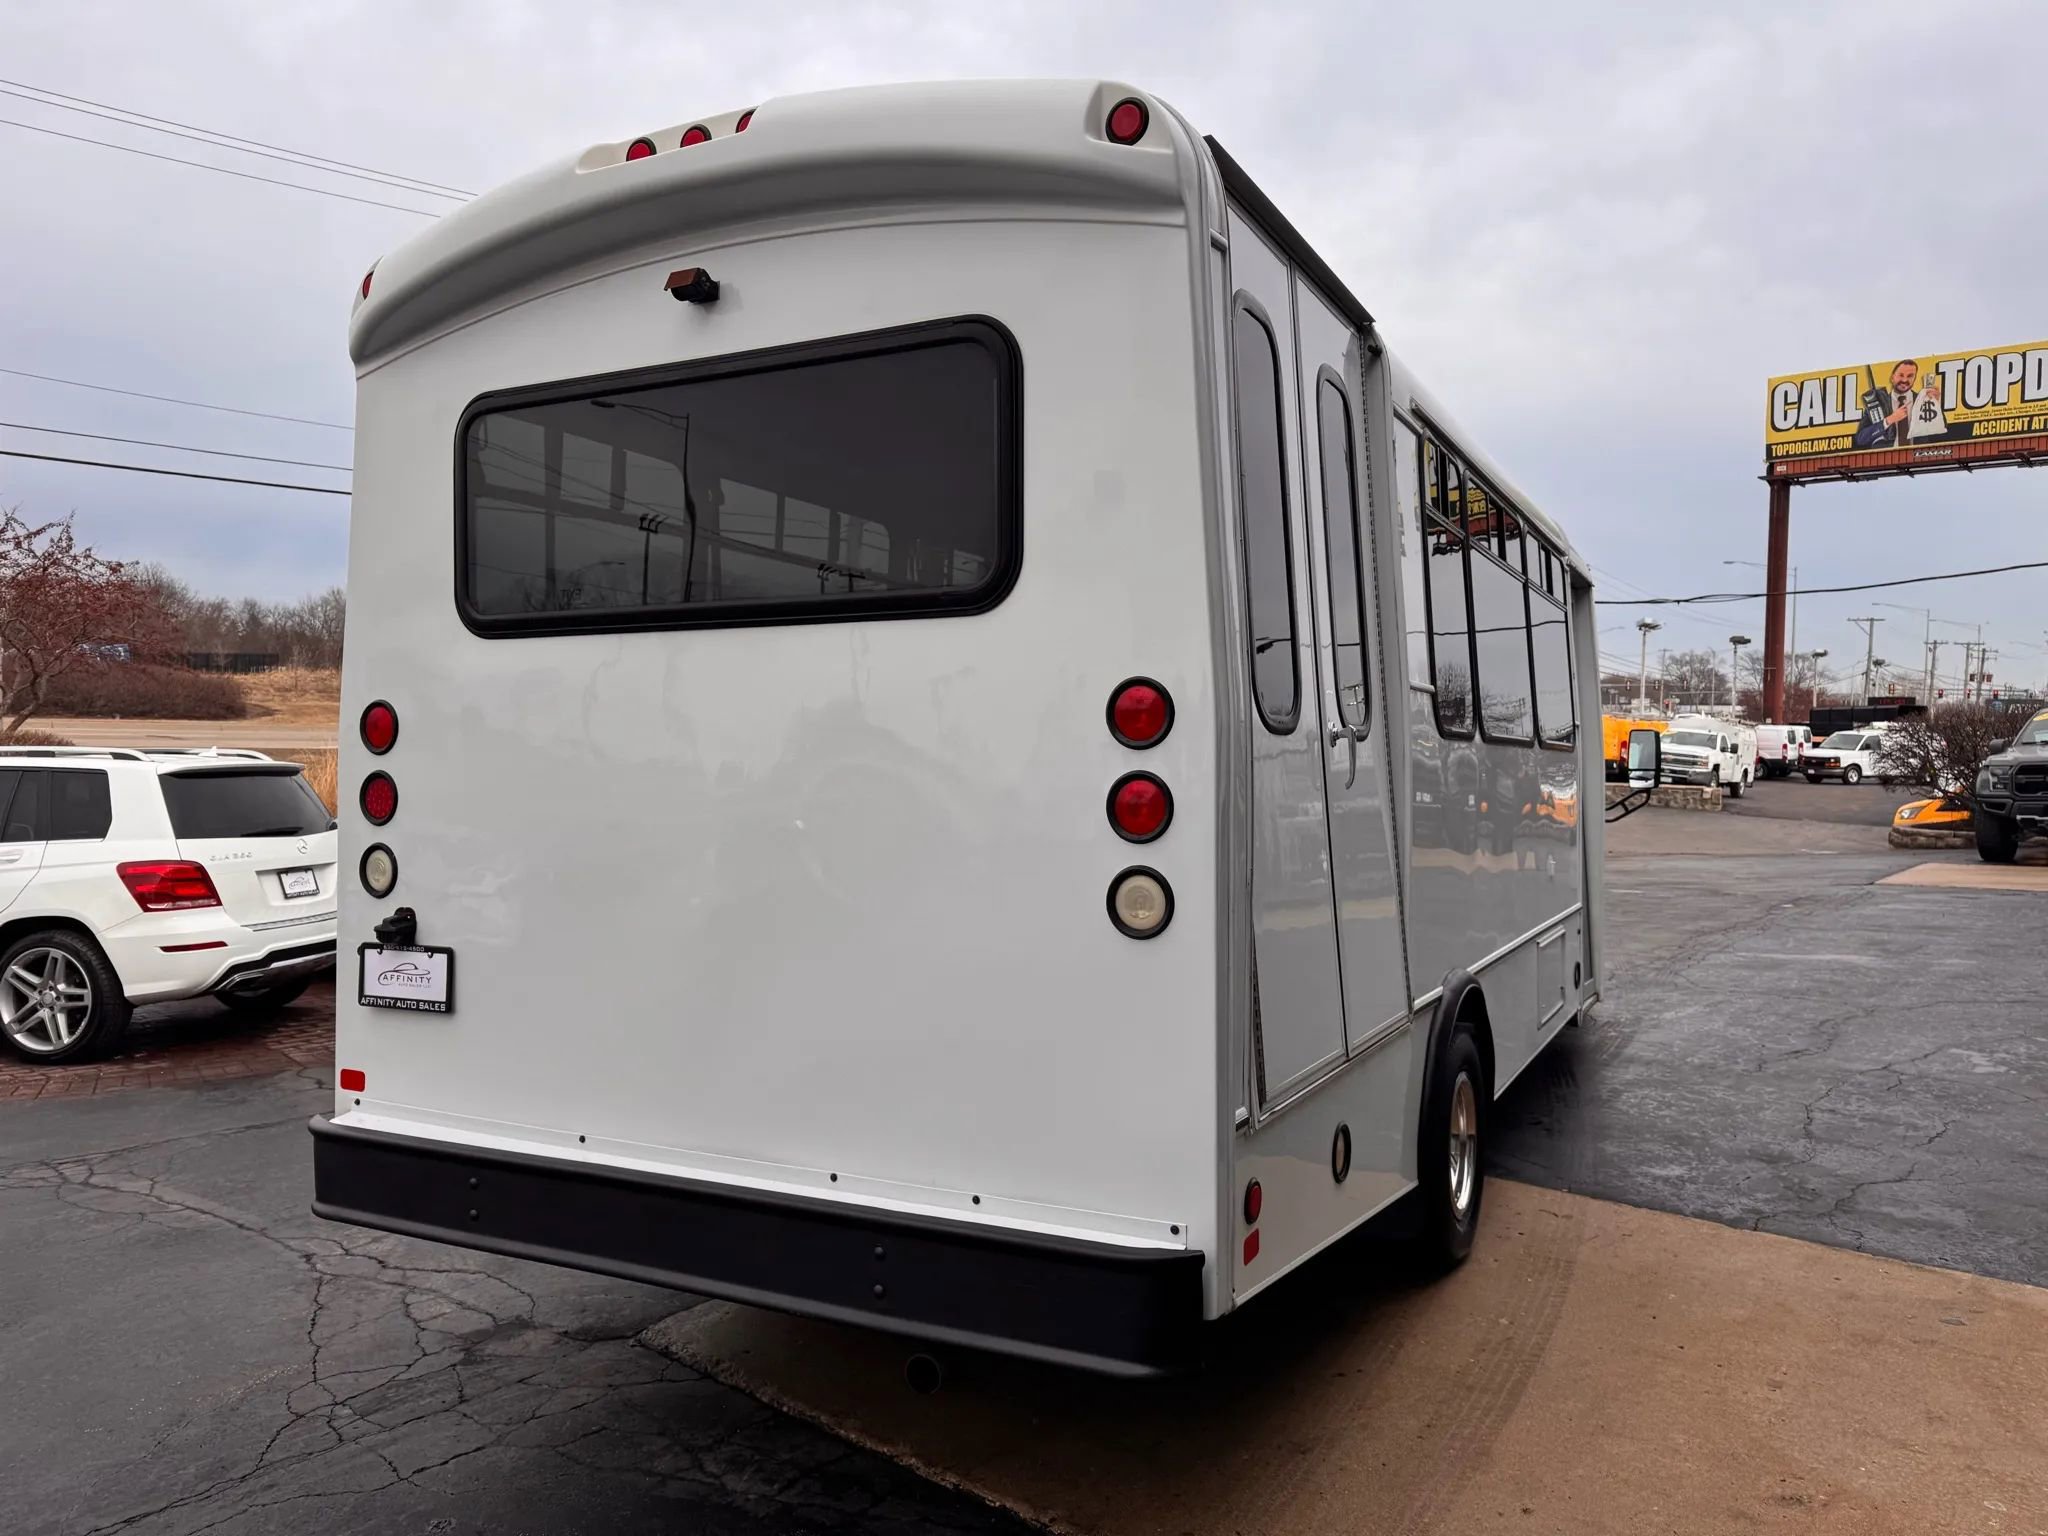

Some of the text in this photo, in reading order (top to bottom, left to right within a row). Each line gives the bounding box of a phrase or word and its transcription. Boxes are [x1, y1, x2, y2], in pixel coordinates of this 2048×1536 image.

[1772, 348, 2048, 431] CALL TOPD
[1972, 417, 2030, 436] ACCIDENT
[1771, 436, 1852, 457] TOPDOGLAW.COM
[1914, 449, 1952, 457] LAMAR
[382, 974, 432, 984] AFFINITY
[360, 996, 446, 1012] AFFINITY AUTO SALES
